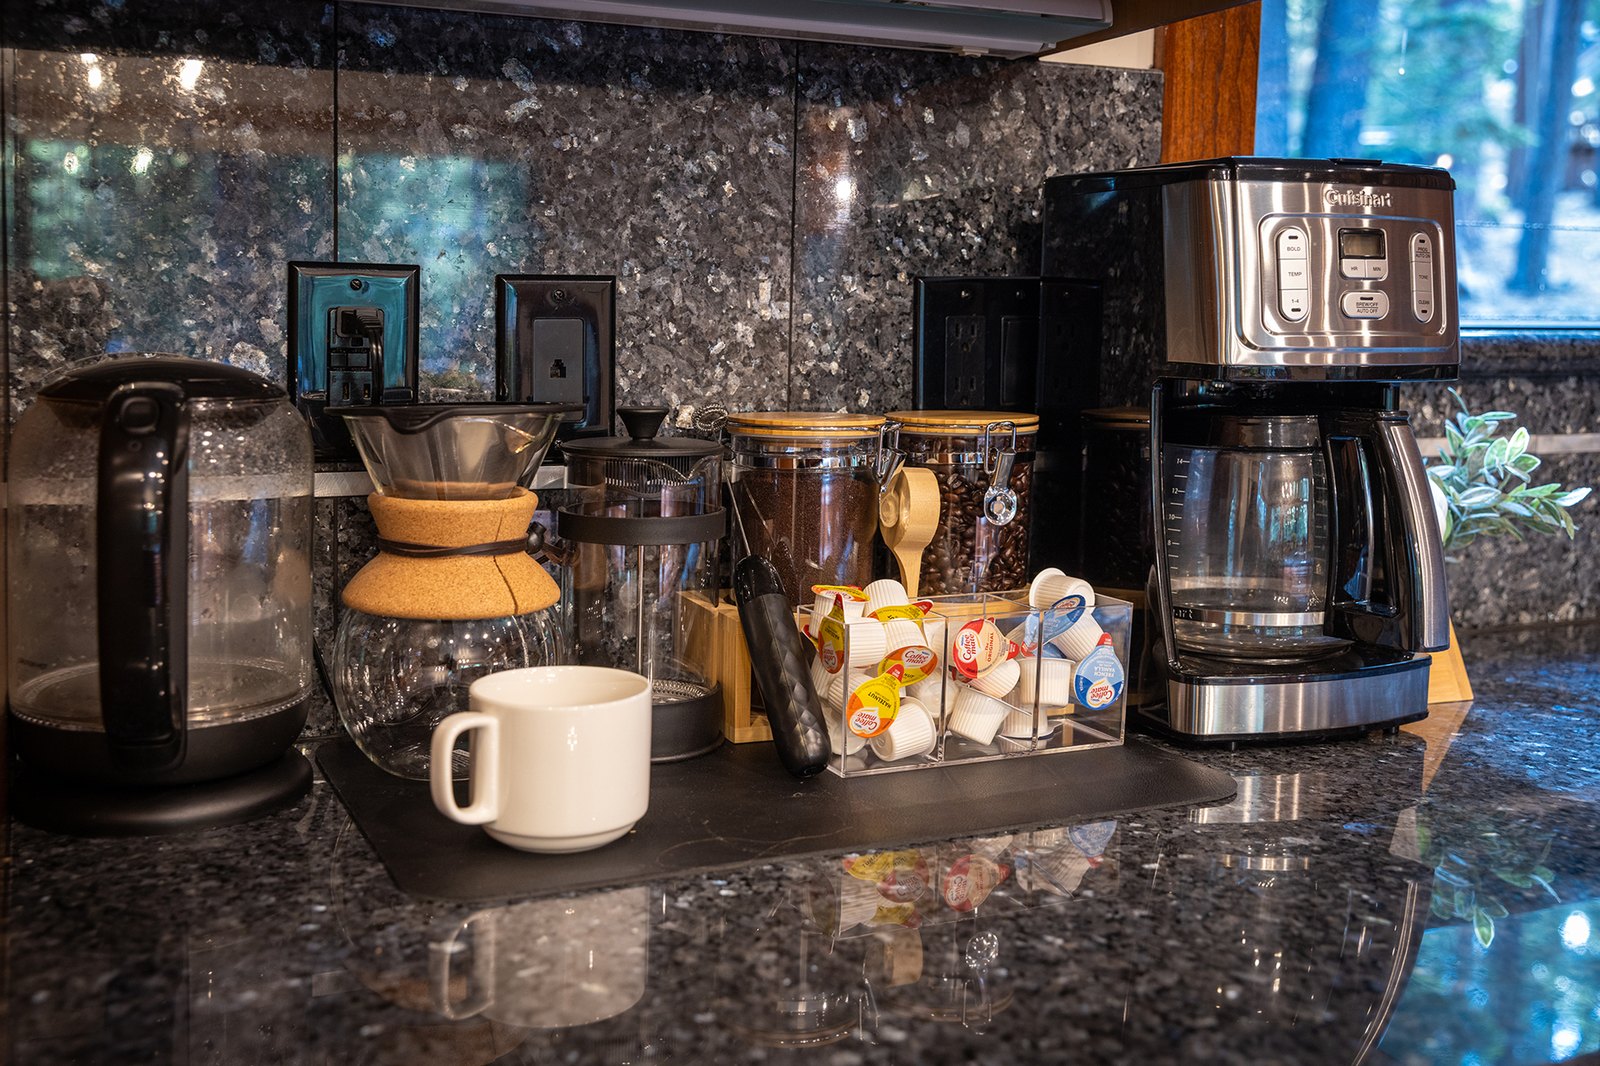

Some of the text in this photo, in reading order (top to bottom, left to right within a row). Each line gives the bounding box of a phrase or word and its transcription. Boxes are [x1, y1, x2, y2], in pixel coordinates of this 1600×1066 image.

[1325, 189, 1392, 207] Cuisinart
[963, 634, 972, 660] Coffee
[905, 650, 929, 660] Coffee
[1094, 665, 1116, 673] VANILLA
[1090, 685, 1109, 694] mate
[868, 691, 892, 709] HAZELNUT
[1090, 690, 1113, 700] Coffee
[857, 712, 877, 722] mate
[855, 717, 878, 731] Coffee
